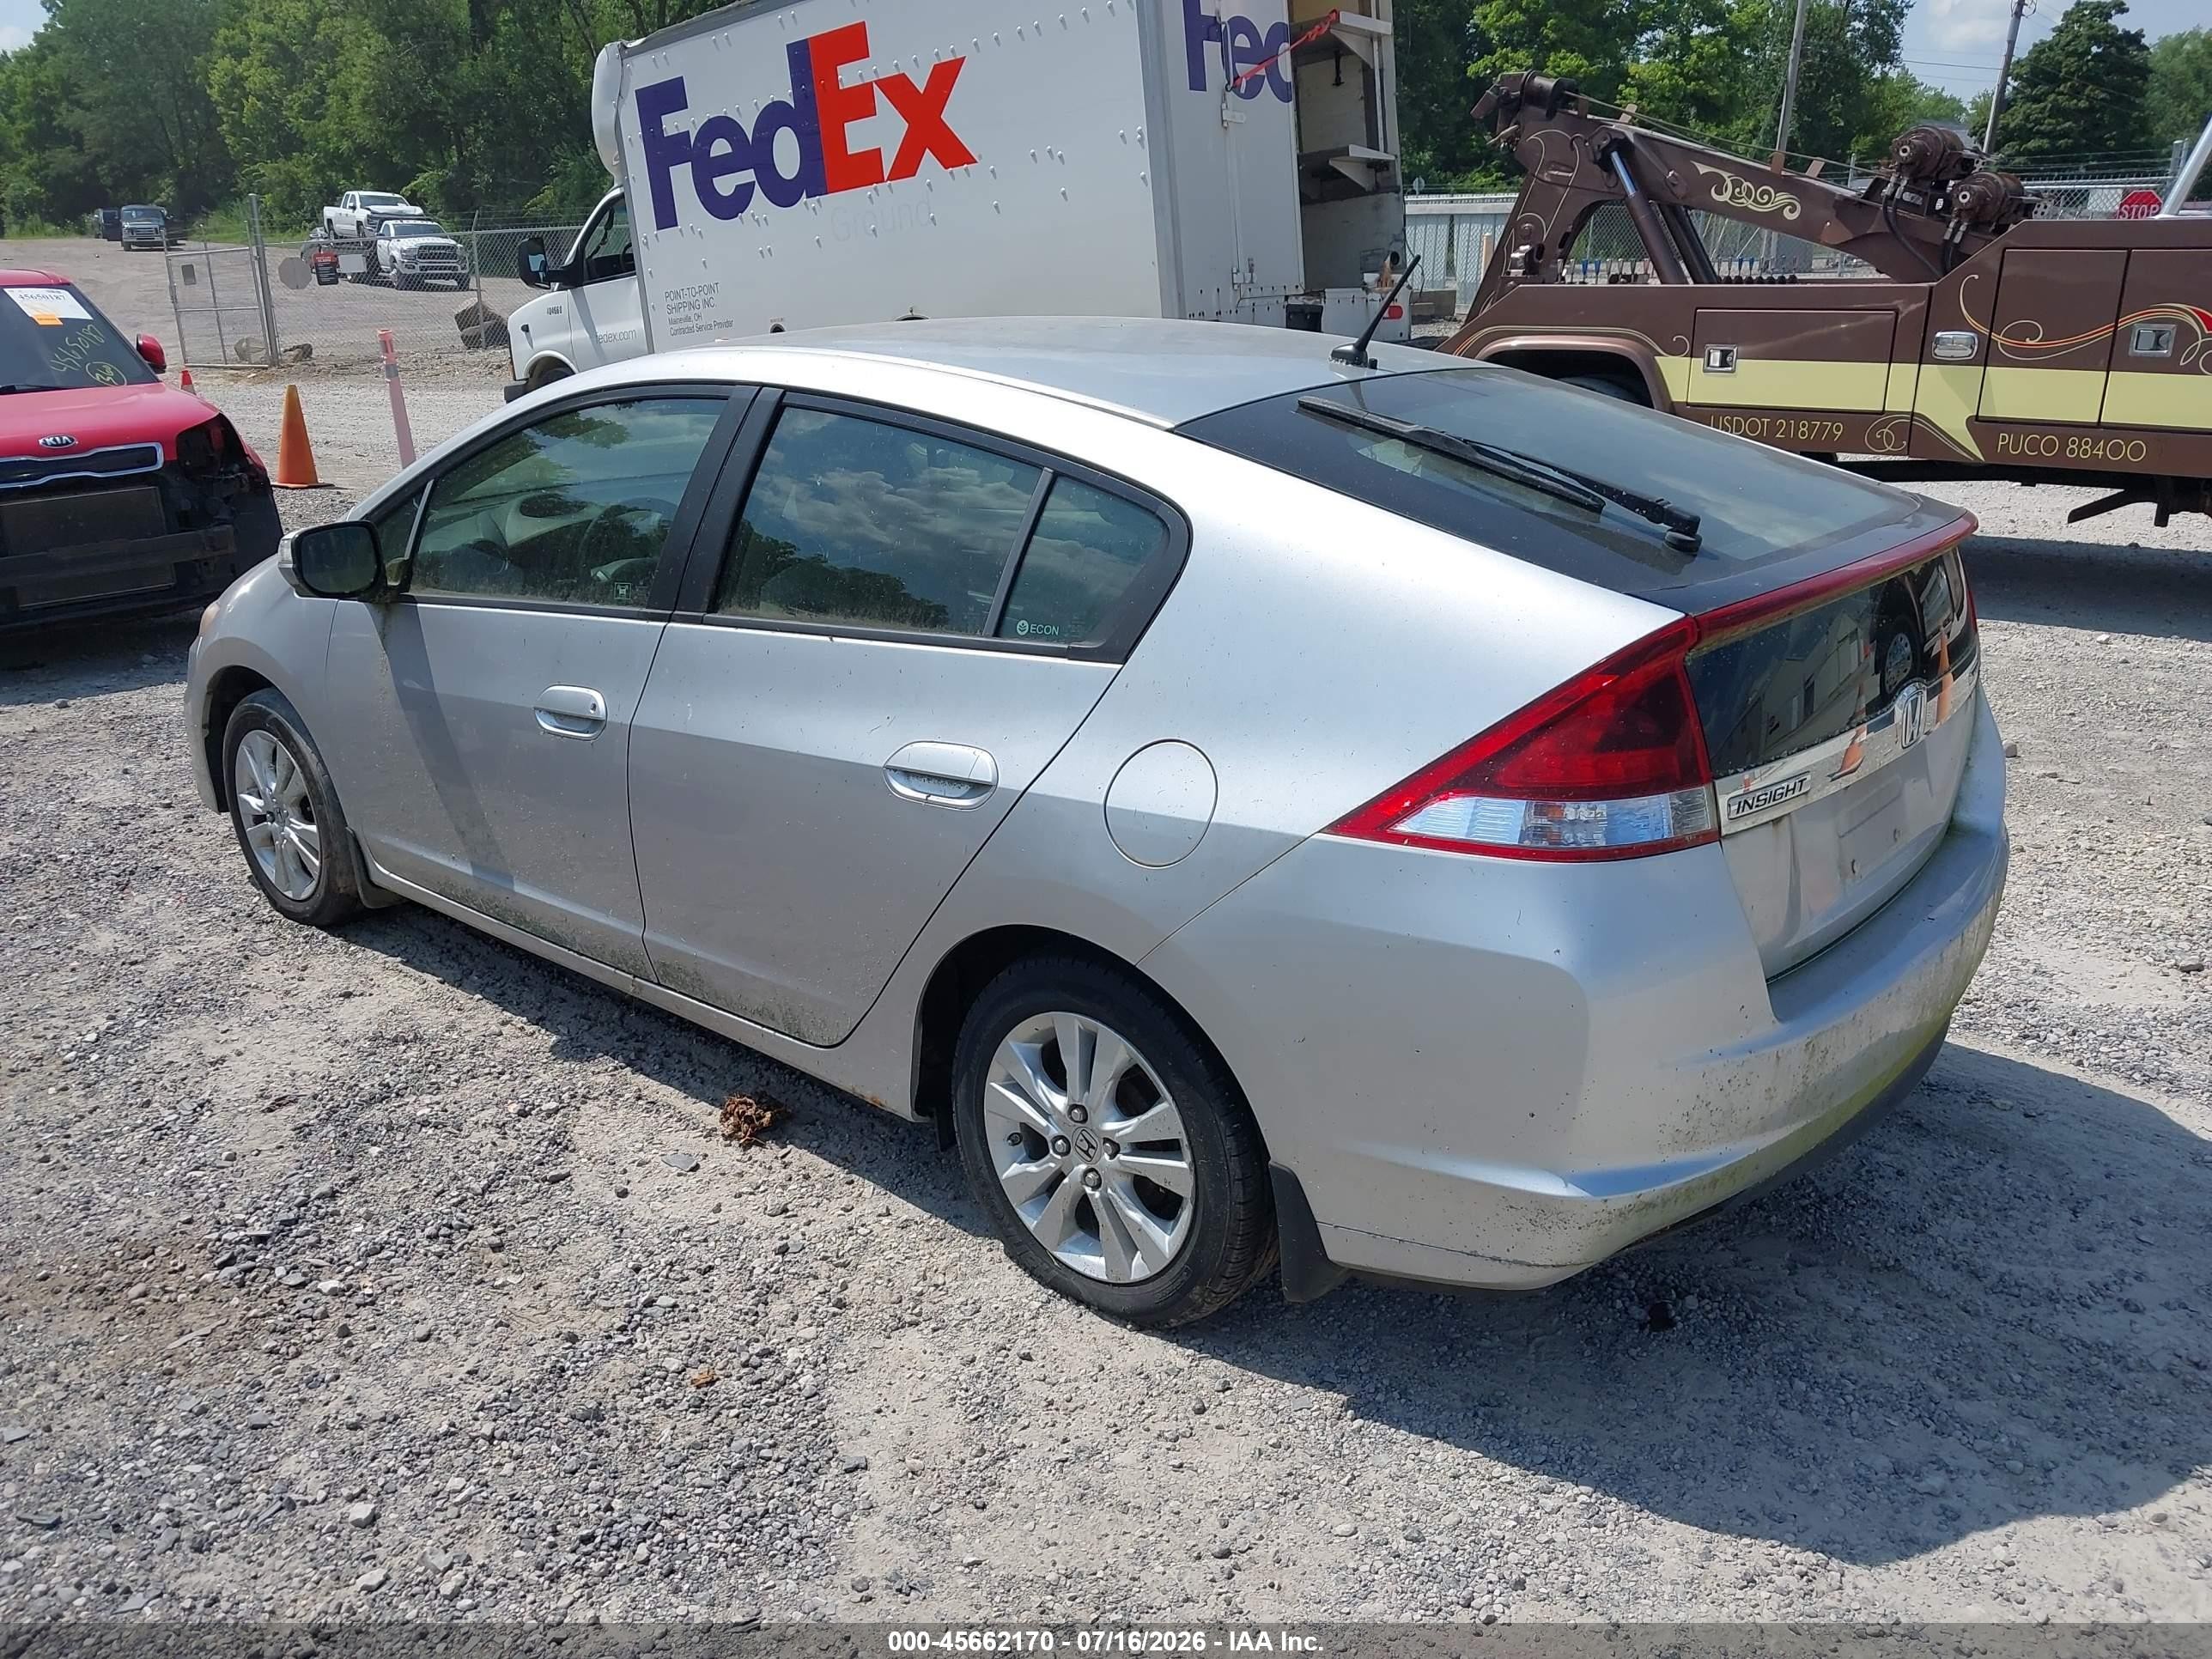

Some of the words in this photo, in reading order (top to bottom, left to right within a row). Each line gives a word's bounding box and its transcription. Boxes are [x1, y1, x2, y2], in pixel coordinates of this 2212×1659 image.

[635, 21, 979, 231] FedEx
[831, 192, 932, 242] Ground
[2118, 204, 2160, 220] STOP
[665, 282, 720, 302] POINT-TO-POINT
[666, 299, 701, 315] SHIPPING
[694, 312, 702, 323] OH
[696, 323, 714, 333] Service
[1711, 416, 1771, 437] USDOT
[1775, 419, 1844, 441] 218779
[45, 435, 72, 446] KIA
[1997, 433, 2059, 456] PUCO
[2066, 436, 2147, 462] 88400
[1030, 624, 1060, 635] ECON
[1736, 777, 1808, 815] INSIGHT
